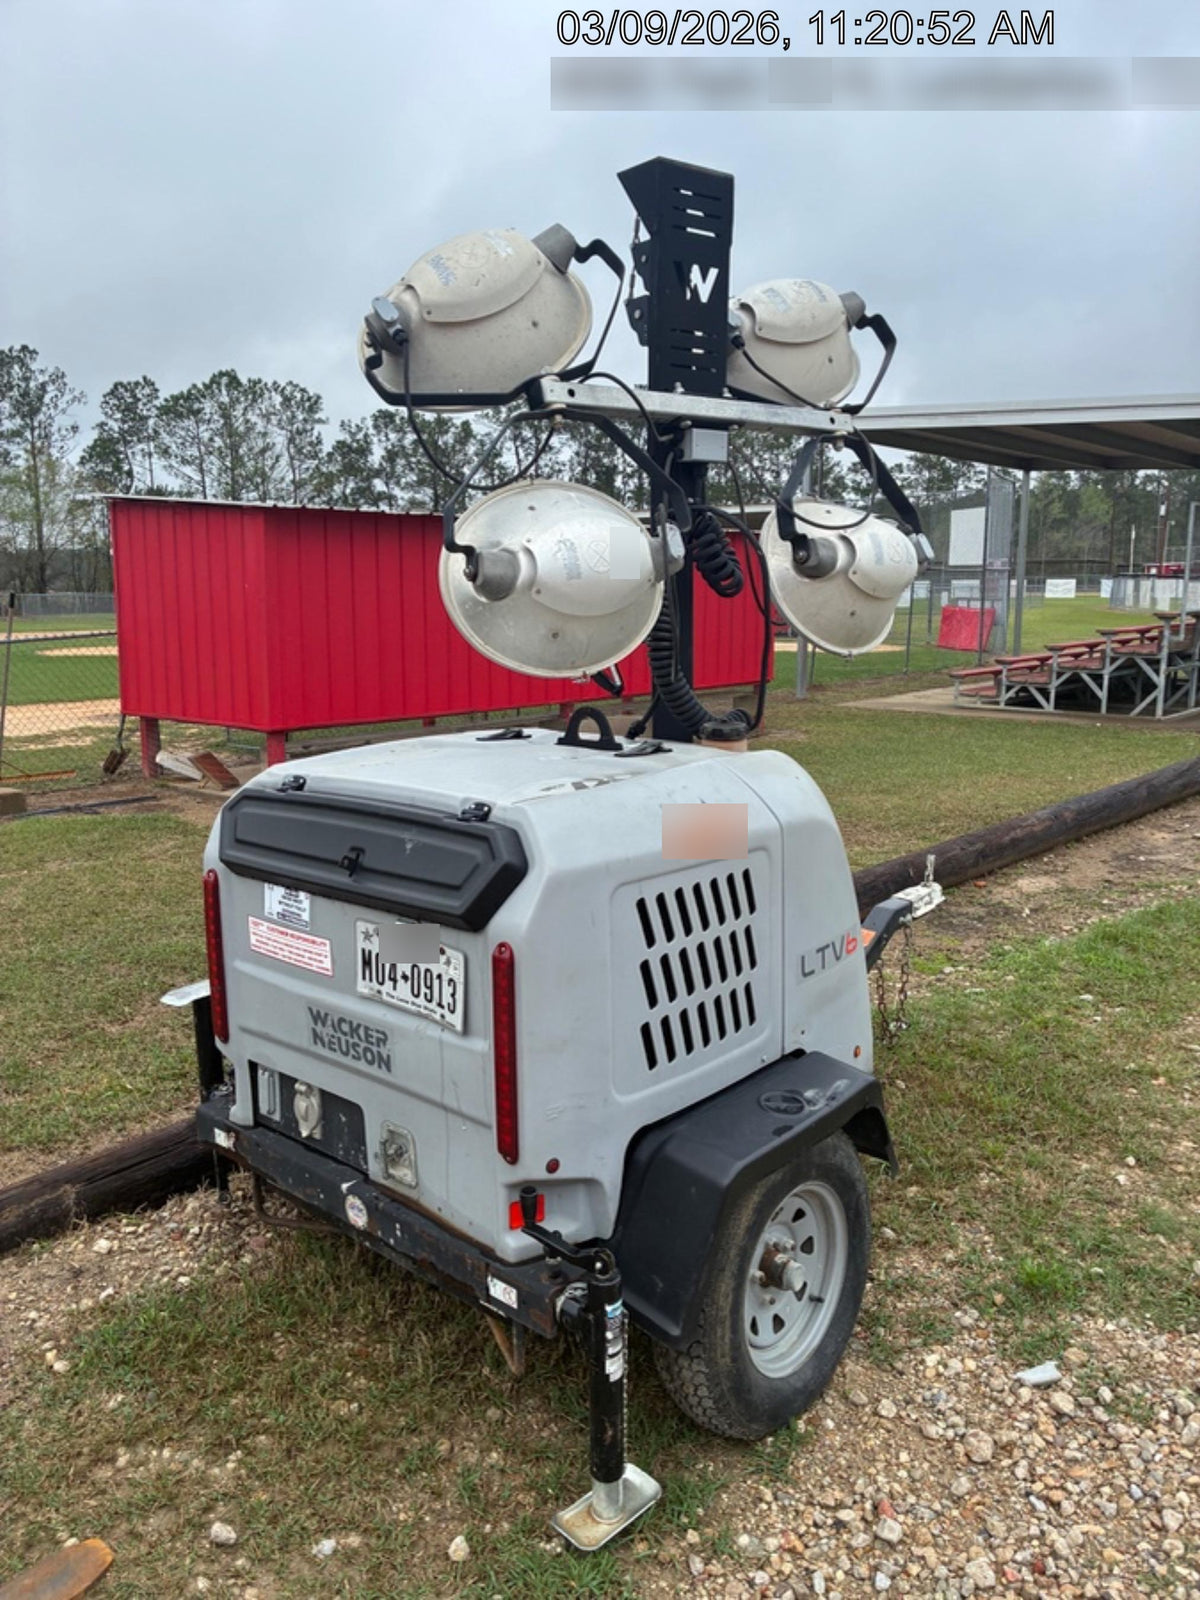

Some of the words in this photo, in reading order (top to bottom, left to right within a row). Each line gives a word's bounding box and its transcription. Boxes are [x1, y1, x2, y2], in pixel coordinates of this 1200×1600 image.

[801, 931, 858, 978] LTV6
[308, 1006, 388, 1048] WACKER
[311, 1027, 391, 1073] NEUSON
